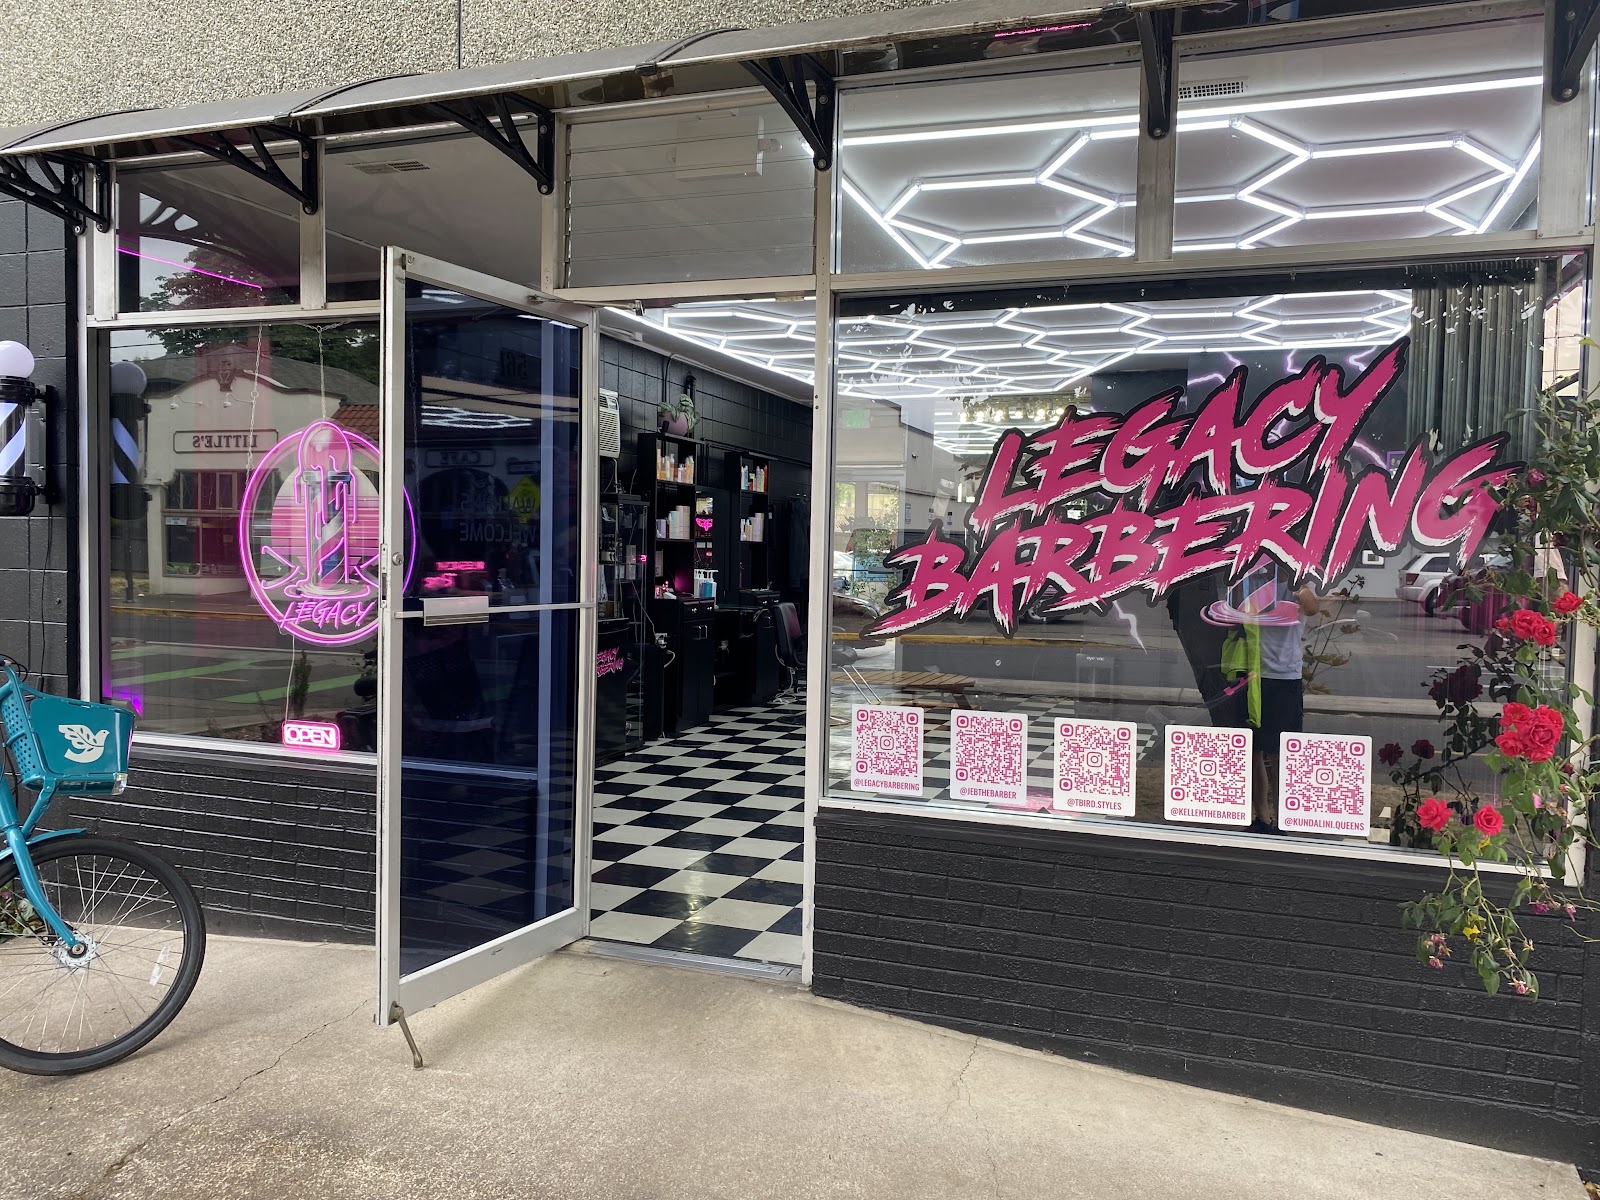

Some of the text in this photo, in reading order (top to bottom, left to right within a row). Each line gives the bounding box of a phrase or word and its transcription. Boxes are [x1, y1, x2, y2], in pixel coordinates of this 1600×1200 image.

[968, 338, 1410, 548] LEGACY
[861, 434, 1523, 636] BARBERING
[278, 600, 376, 630] LEGACY
[597, 646, 620, 664] EGACY
[286, 727, 334, 745] OPEN
[854, 778, 920, 791] @LEGACYBARBERING
[960, 787, 1017, 800] @JEBTHEBARBER
[1066, 797, 1122, 811] @TBIRD.STYLES
[1170, 807, 1246, 821] @KELLENTHEBARBER
[1284, 817, 1365, 831] @KUNDALINI.QUEENS
